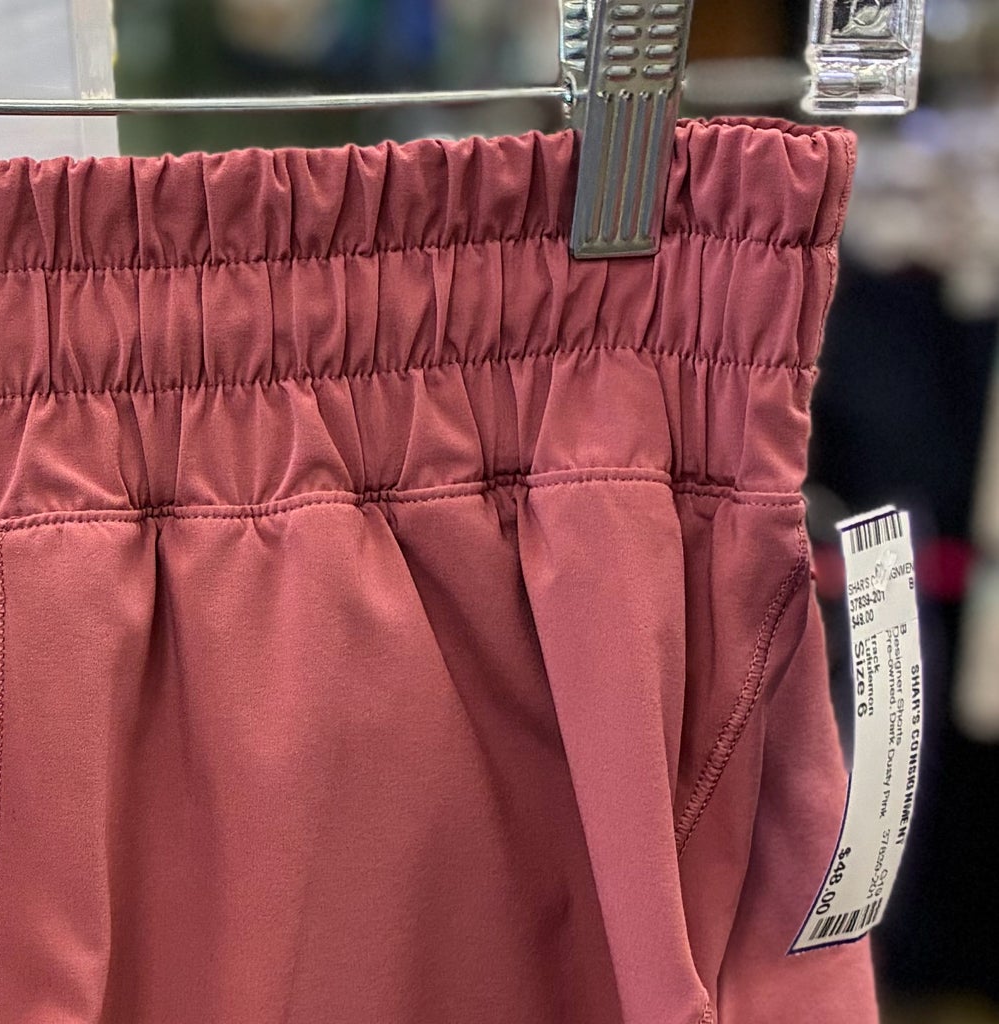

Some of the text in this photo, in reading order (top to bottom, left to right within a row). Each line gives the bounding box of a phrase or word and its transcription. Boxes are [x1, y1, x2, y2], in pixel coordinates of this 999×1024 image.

[852, 608, 874, 630] $48.00
[864, 638, 875, 716] Lululemon
[871, 634, 880, 673] track
[854, 640, 868, 718] Size 6
[893, 626, 904, 746] Designer Shorts
[910, 664, 921, 725] SHAR'S
[888, 712, 896, 746] Dark
[883, 748, 895, 786] Dusty
[879, 789, 891, 820] Pink
[815, 846, 852, 915] $48.00
